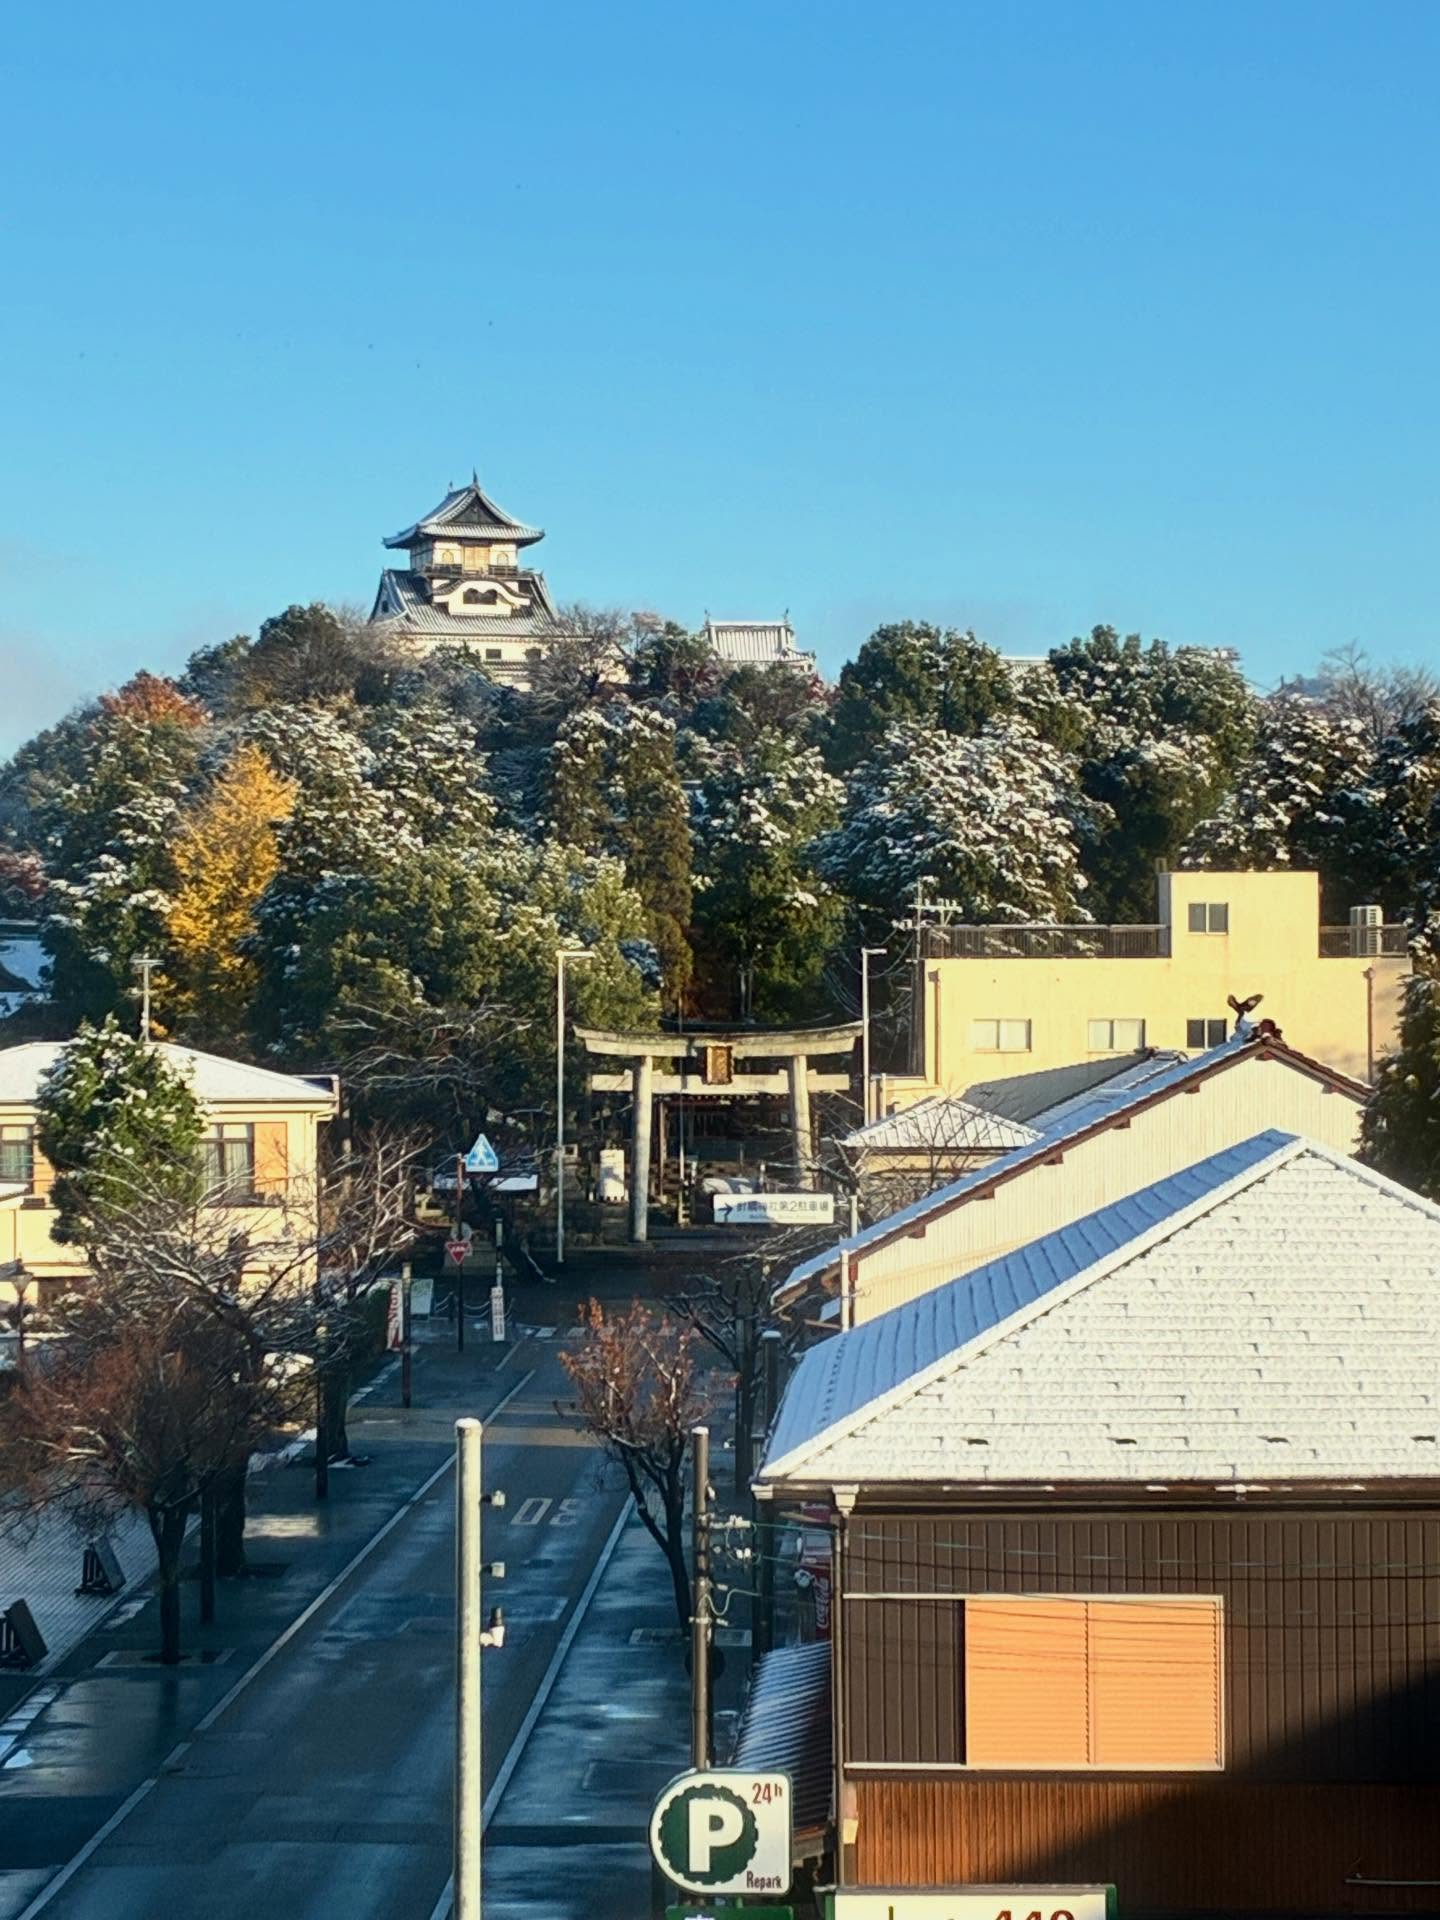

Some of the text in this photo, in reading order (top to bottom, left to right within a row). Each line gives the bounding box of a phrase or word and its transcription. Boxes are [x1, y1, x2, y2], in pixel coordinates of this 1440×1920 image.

[752, 1782, 783, 1805] 24h
[688, 1798, 744, 1872] P
[746, 1870, 782, 1891] Repark
